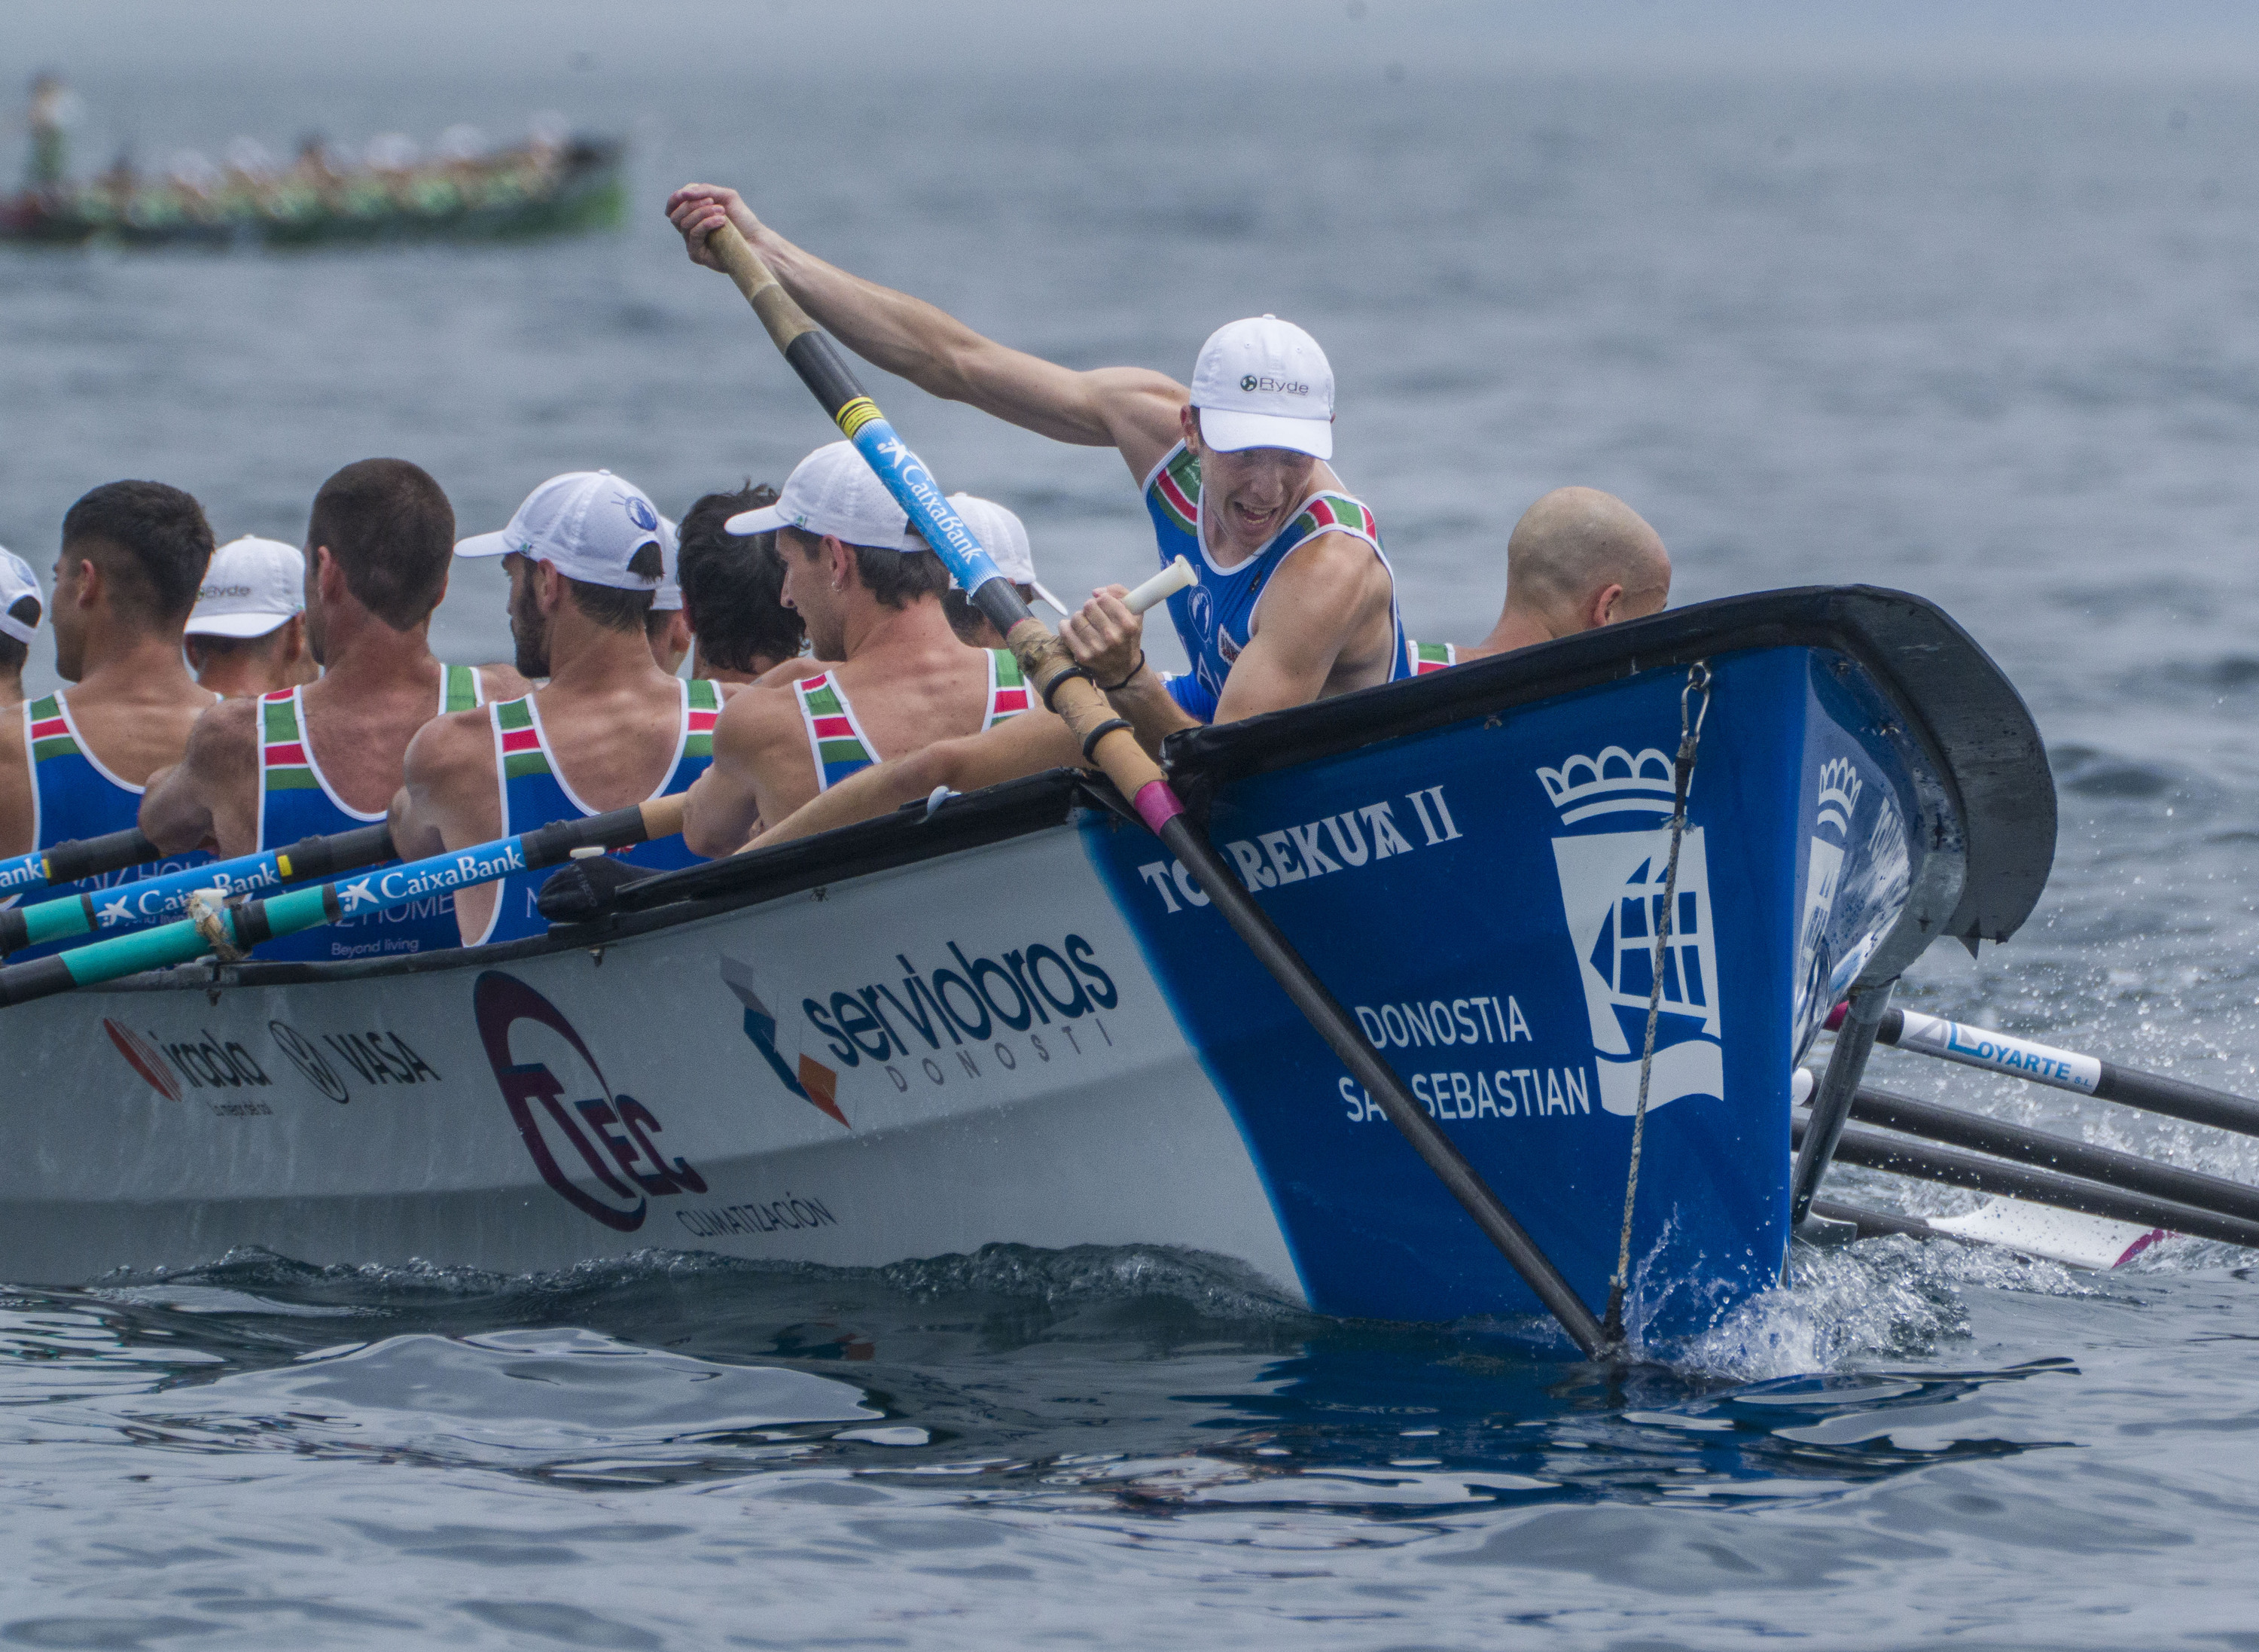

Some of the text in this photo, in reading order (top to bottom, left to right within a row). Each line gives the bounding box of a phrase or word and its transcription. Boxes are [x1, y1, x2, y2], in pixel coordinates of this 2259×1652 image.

[1259, 377, 1309, 393] Ryde
[903, 465, 983, 565] CaixaBank
[0, 858, 44, 887] ank
[380, 846, 526, 899] CaixaBank
[1138, 785, 1463, 913] TOREKUA II
[139, 862, 281, 916] CaiBank
[331, 937, 419, 958] Beyond living
[802, 934, 1118, 1068] serviobras
[1355, 995, 1532, 1050] DONOSTIA
[322, 1031, 442, 1085] VASA
[885, 1018, 1113, 1093] DONOSTI
[1947, 1021, 2072, 1081] LOYARTE
[1338, 1066, 1590, 1122] SA SEBASTIAN
[676, 1191, 837, 1237] CLIMATIZACIÓN
